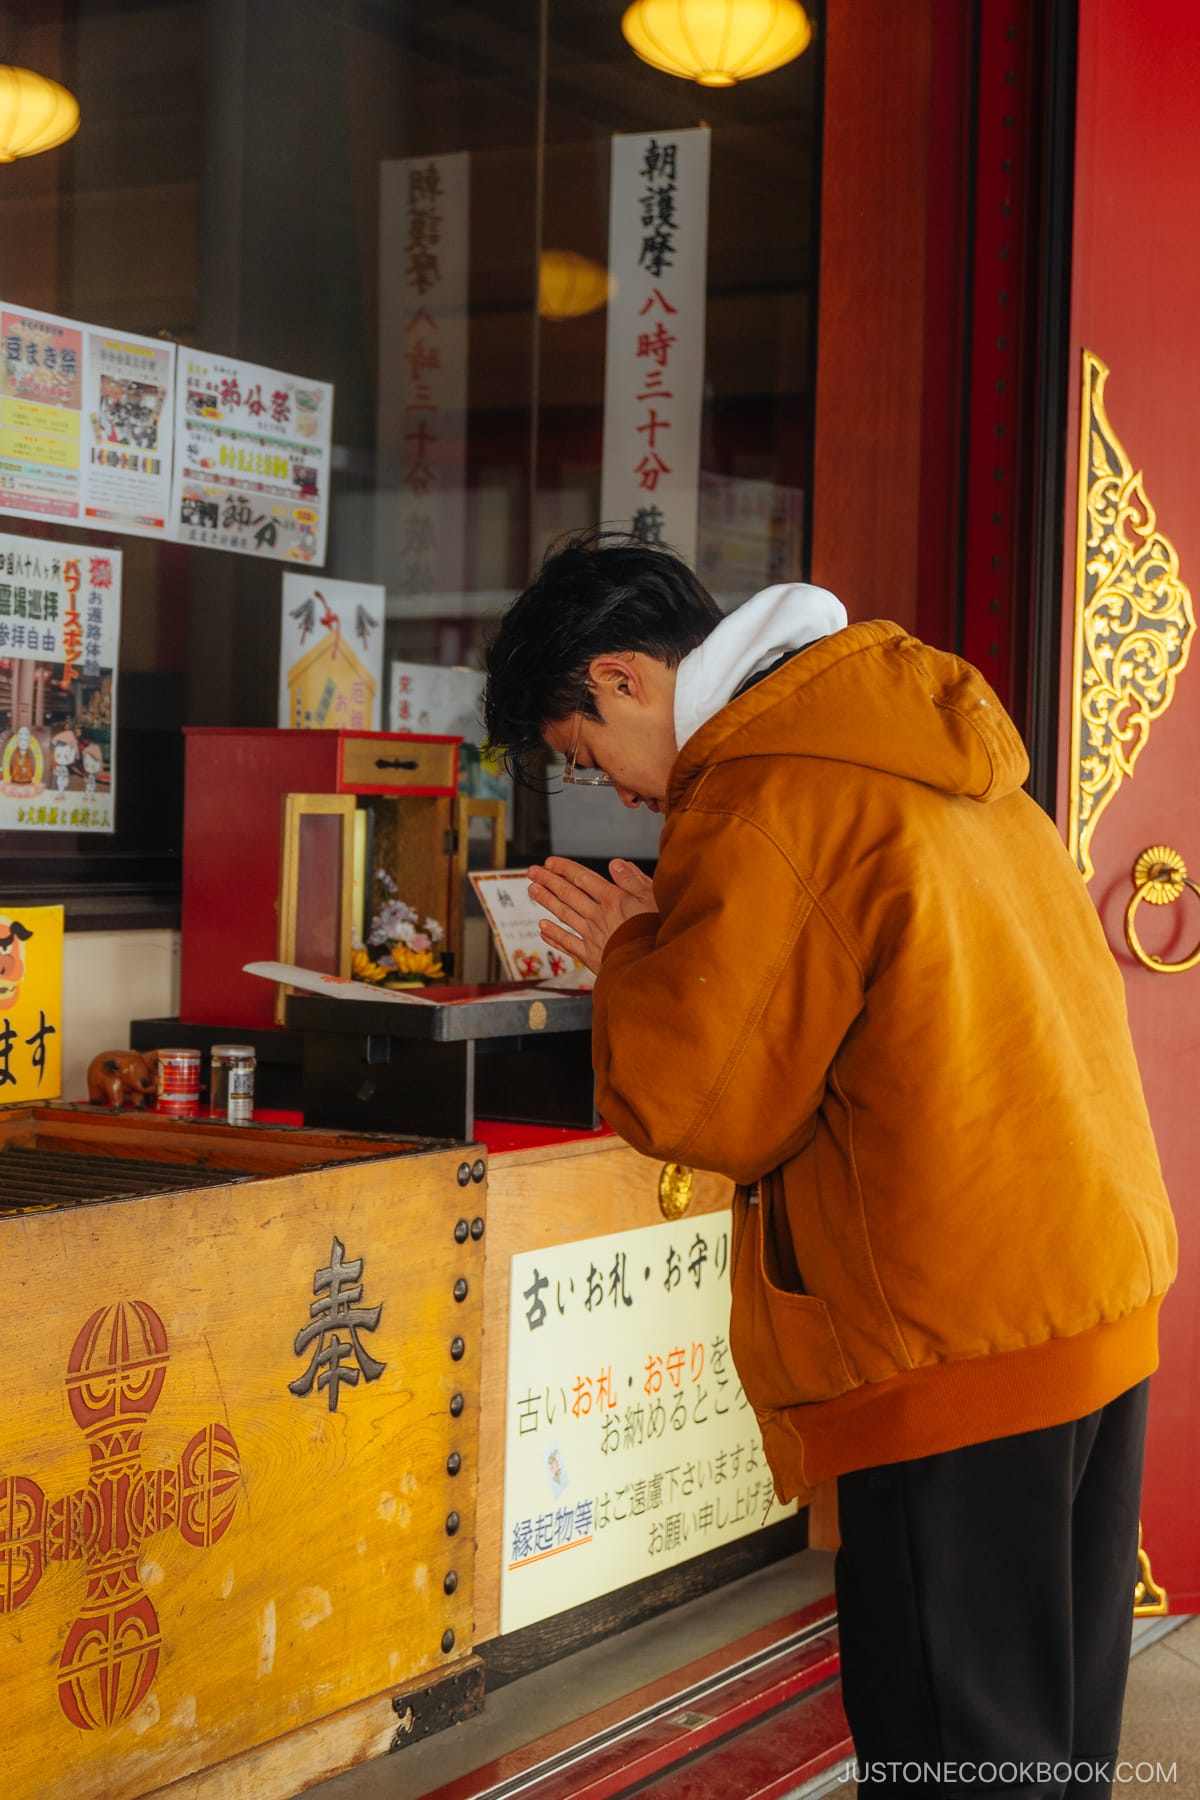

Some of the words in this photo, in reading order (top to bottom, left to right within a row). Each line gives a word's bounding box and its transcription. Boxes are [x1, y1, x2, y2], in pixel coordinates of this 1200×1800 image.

[0, 622, 56, 653] 参拝自由
[63, 559, 82, 688] パワースポット
[288, 1235, 388, 1413] 奉
[523, 1232, 728, 1331] 古いお札・お守り
[517, 1335, 729, 1437] 古いお札・お守りを
[511, 1439, 768, 1561] 縁起物等はご遠慮下さいますよ
